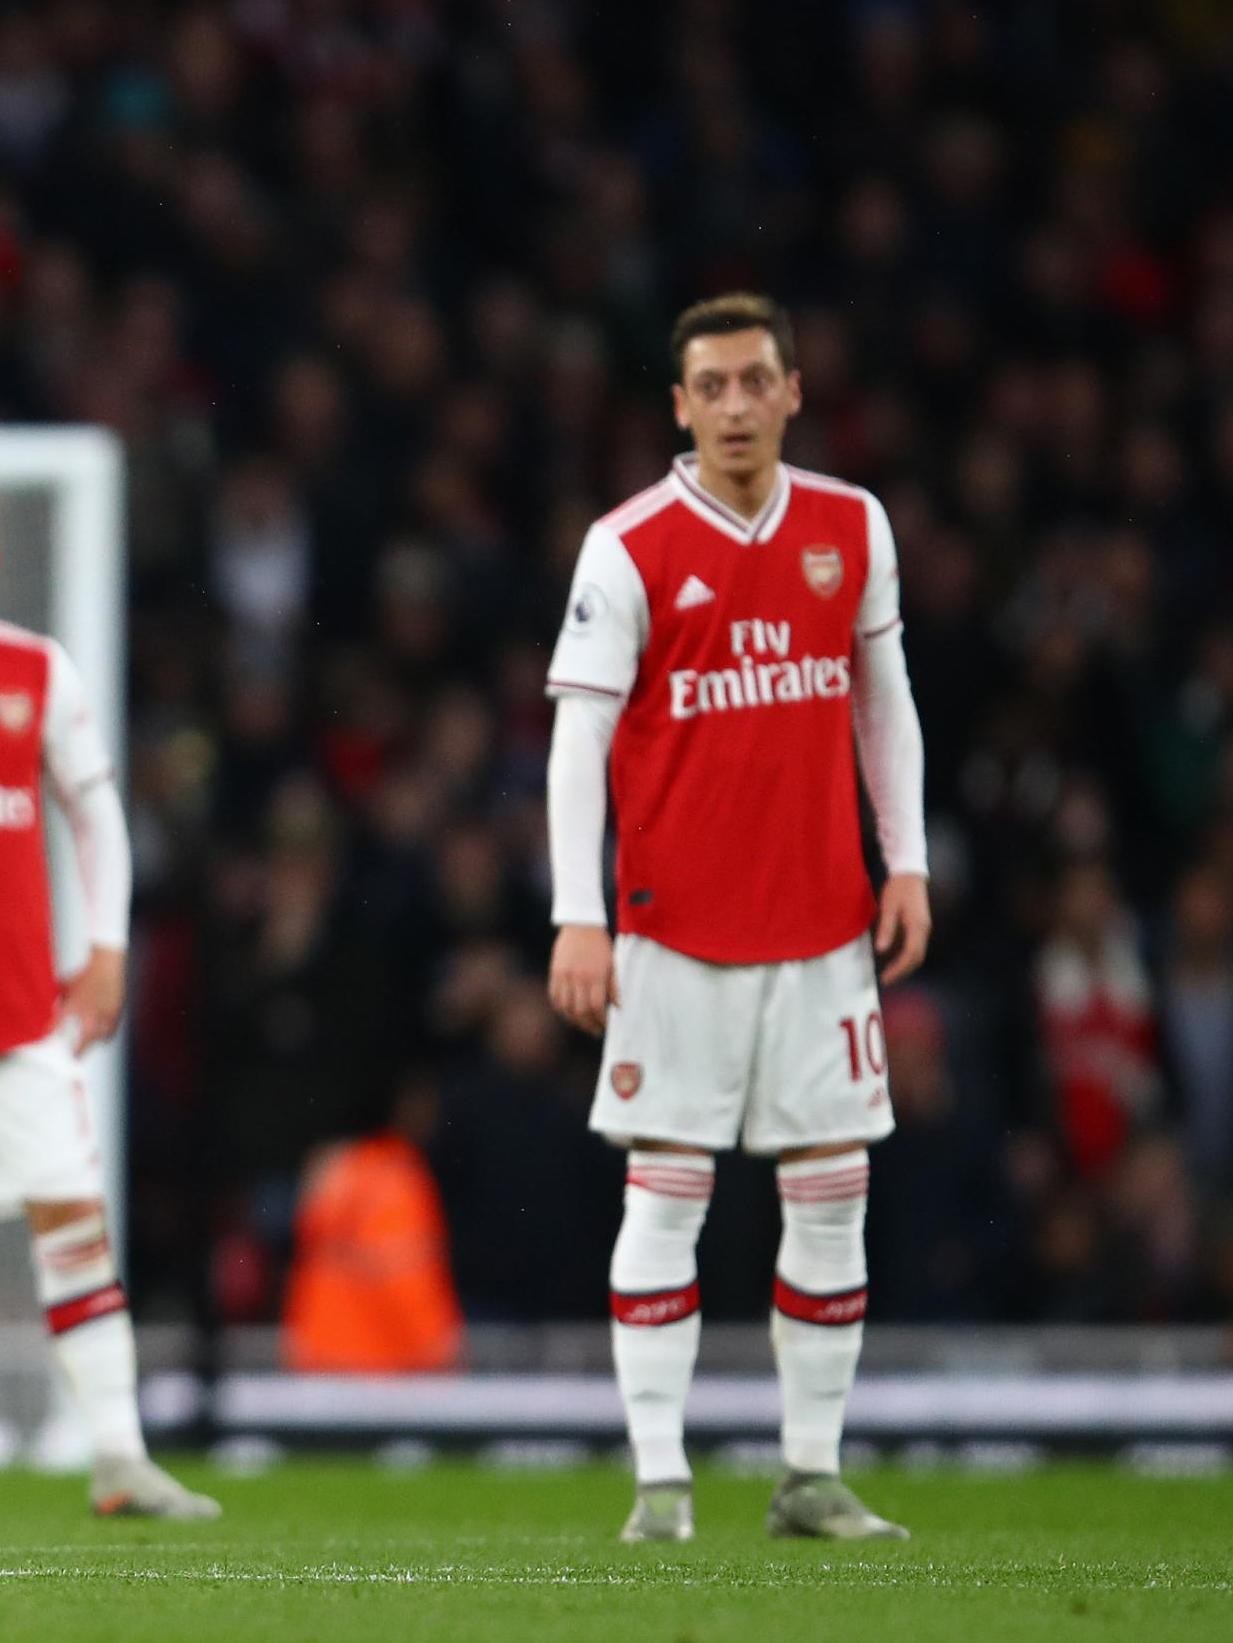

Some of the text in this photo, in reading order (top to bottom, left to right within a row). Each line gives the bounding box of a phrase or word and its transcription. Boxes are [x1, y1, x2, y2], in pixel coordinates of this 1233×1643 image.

[730, 617, 791, 658] Fly
[670, 653, 850, 720] Emirates
[839, 1011, 888, 1082] 10
